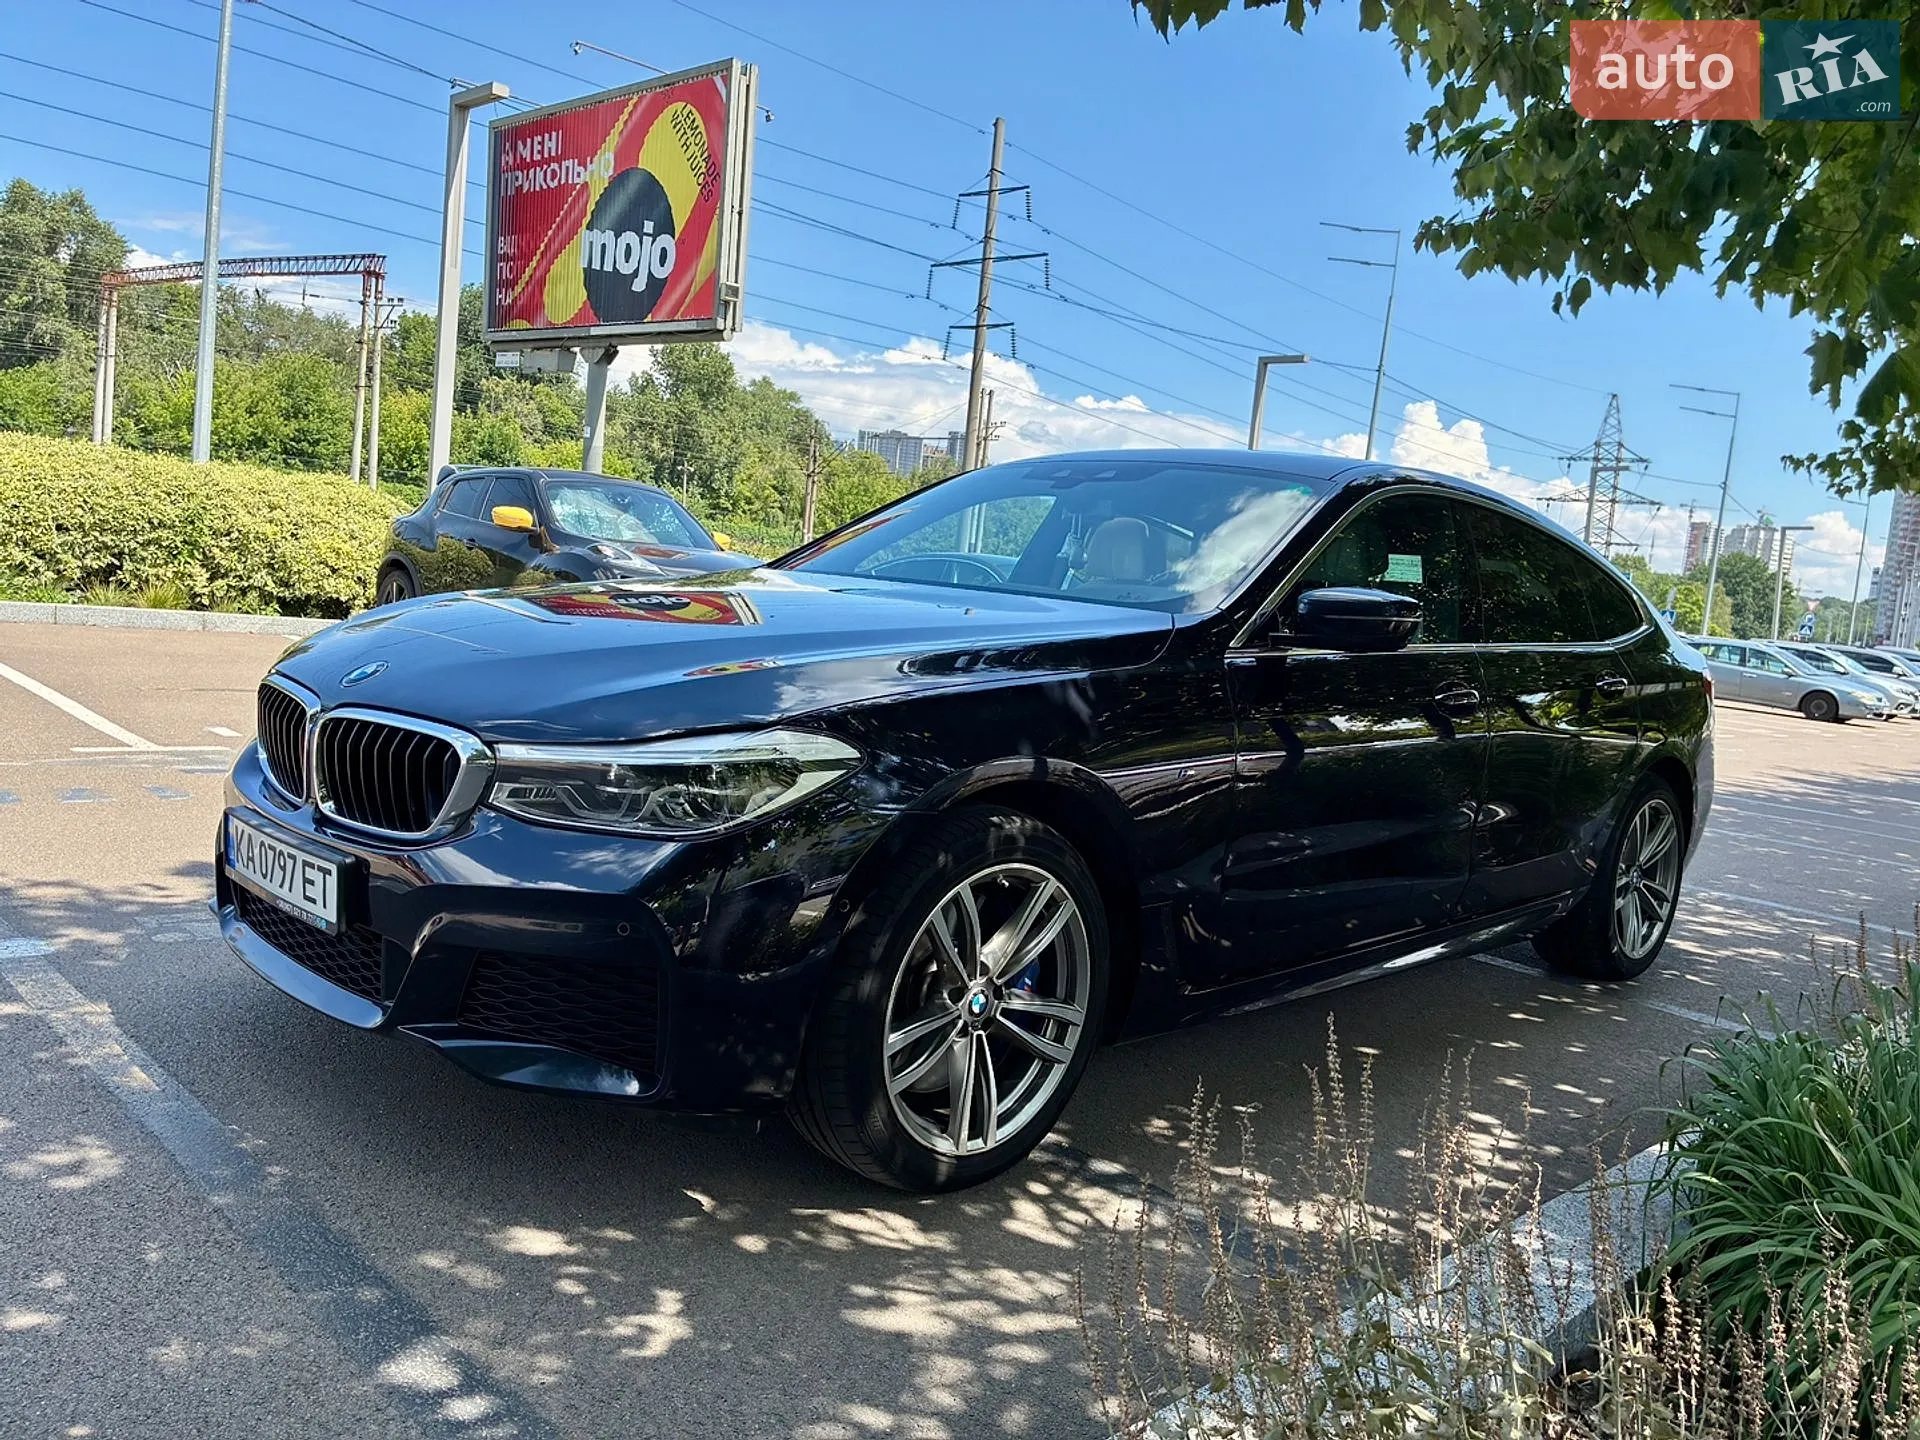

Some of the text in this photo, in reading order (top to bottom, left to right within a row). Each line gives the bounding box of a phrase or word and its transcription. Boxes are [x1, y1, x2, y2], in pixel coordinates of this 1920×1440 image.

[671, 109, 713, 203] WITH JUICES
[680, 103, 720, 187] LEMONADE
[582, 220, 676, 292] mojo
[235, 825, 332, 909] KA 0797 ET
